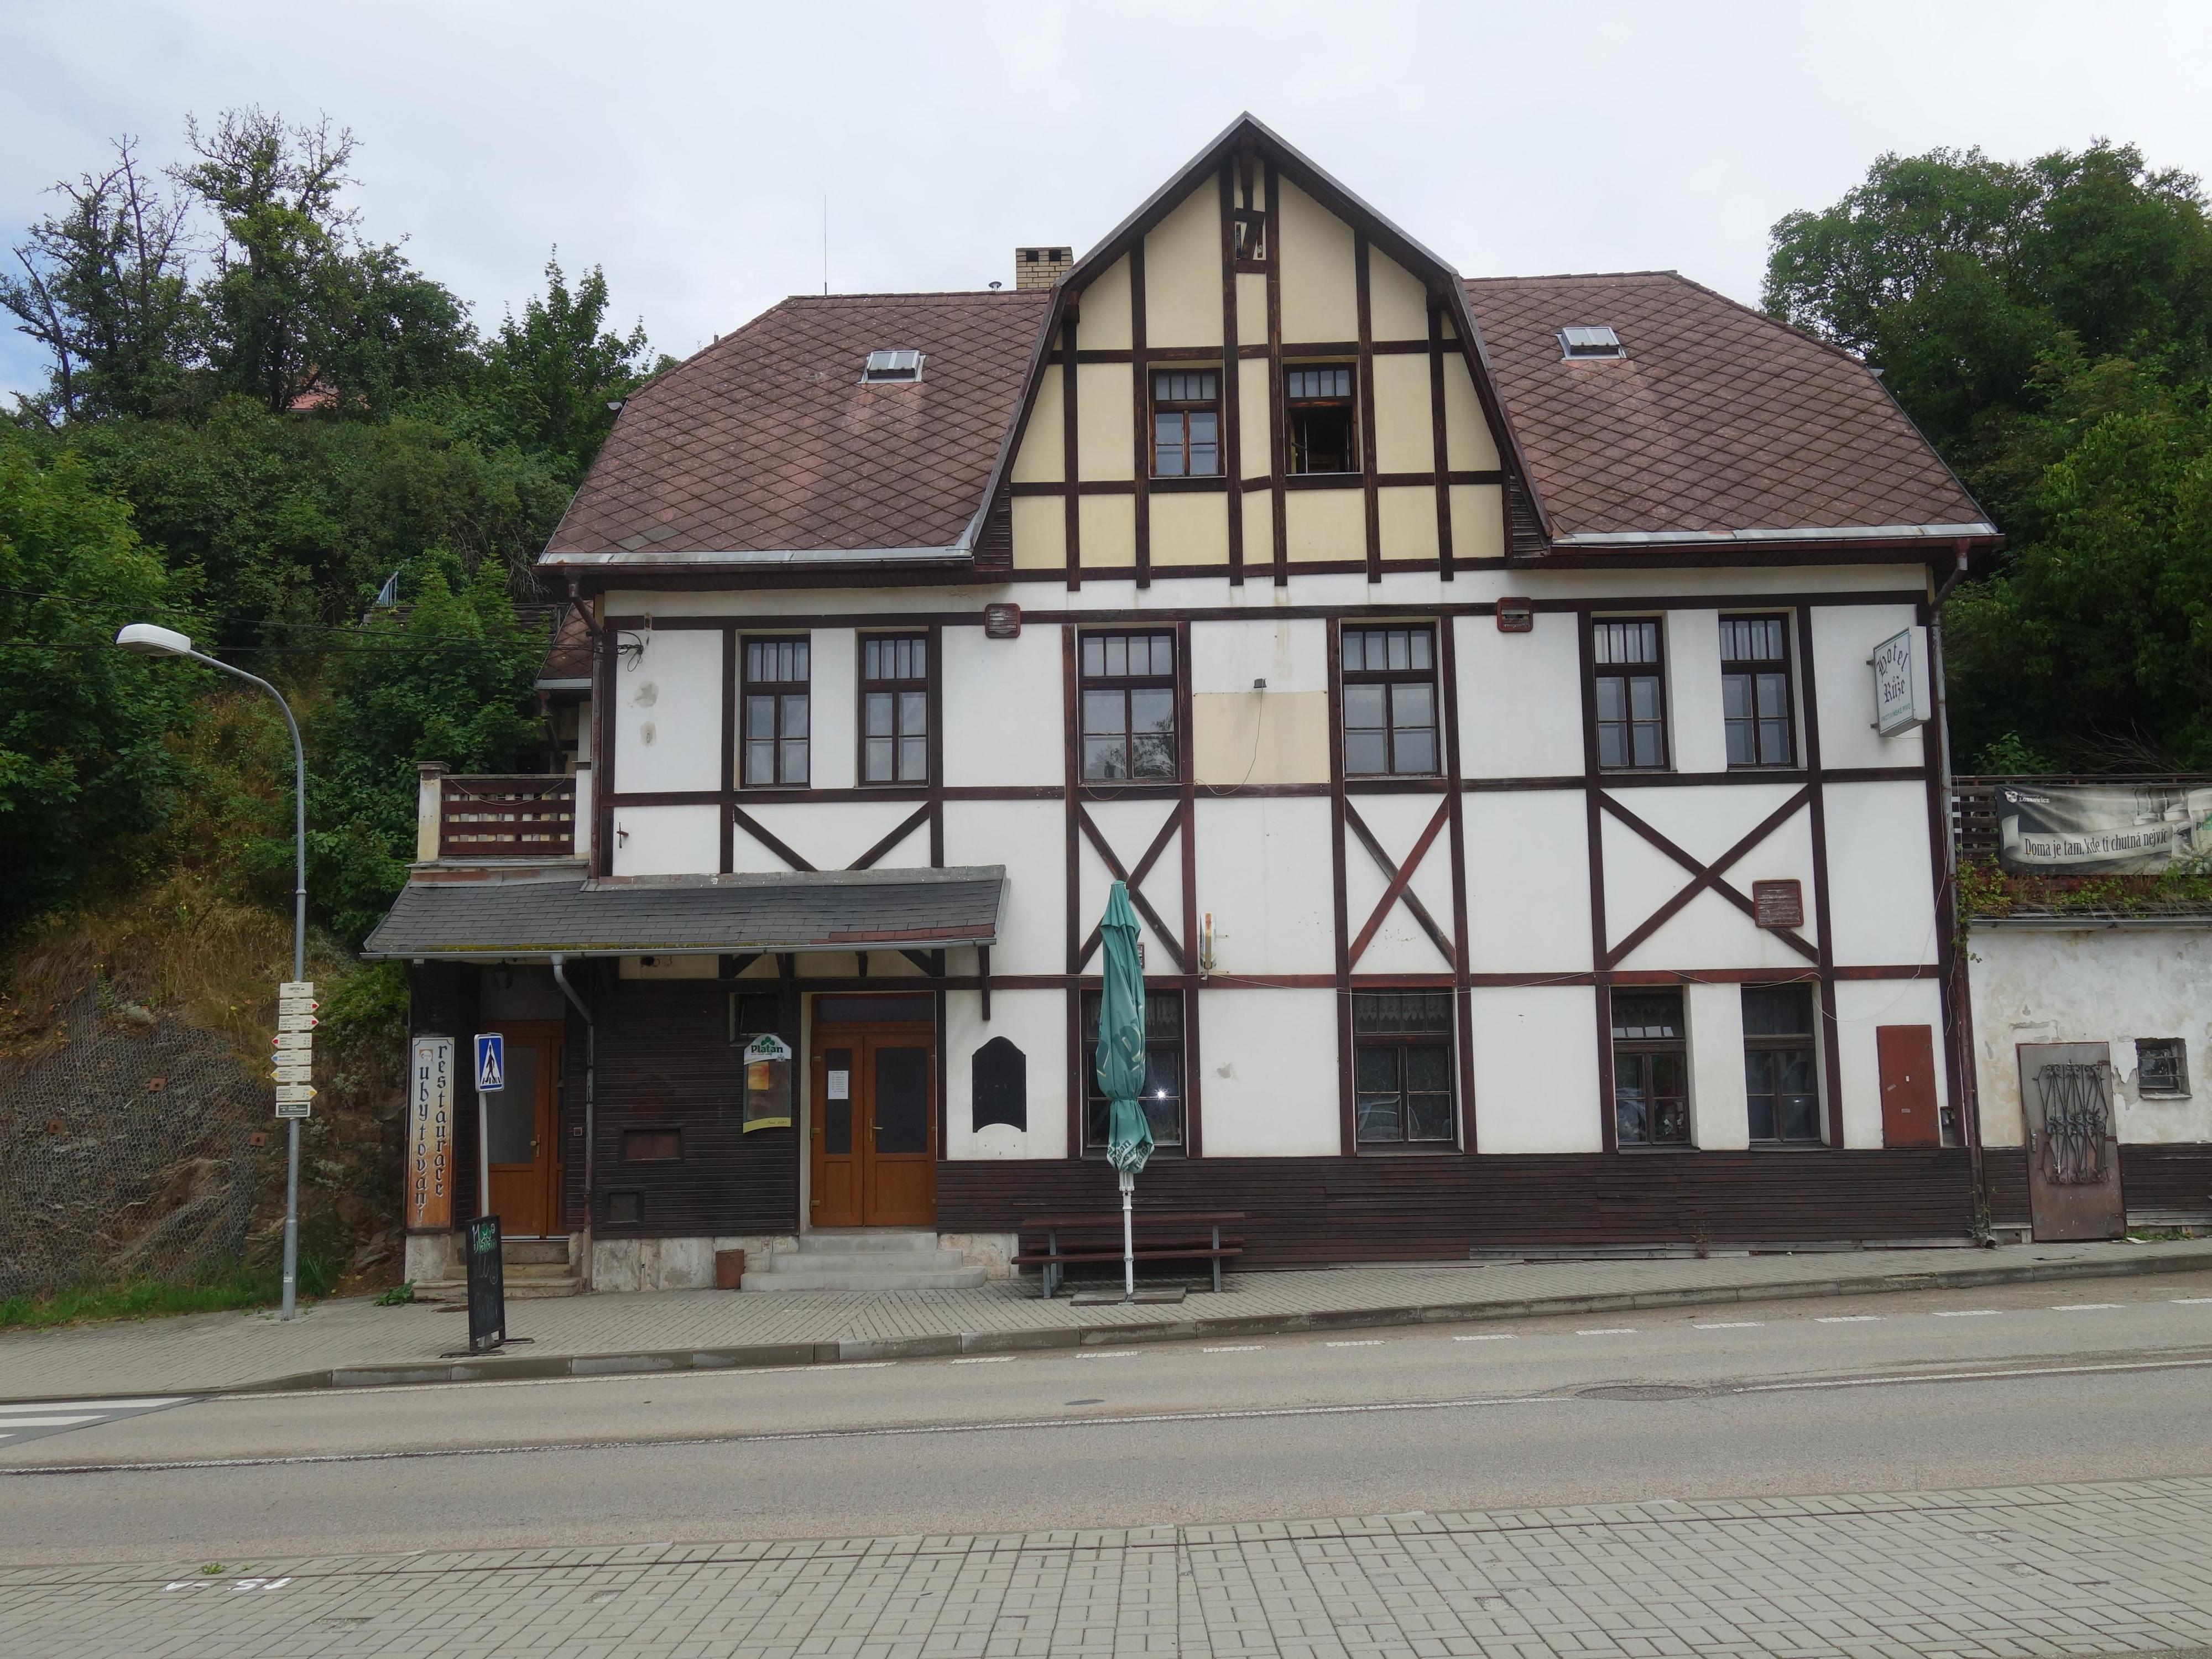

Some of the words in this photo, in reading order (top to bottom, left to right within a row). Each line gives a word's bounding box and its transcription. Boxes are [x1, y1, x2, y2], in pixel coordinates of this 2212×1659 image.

[1876, 641, 1908, 682] Hotel
[2025, 838, 2051, 857] Doma
[2052, 840, 2062, 859] je
[2064, 842, 2084, 857] tam,
[2085, 837, 2100, 854] kde
[2111, 832, 2142, 852] chutná
[2143, 828, 2168, 848] nejvíc
[751, 1044, 784, 1053] Platan
[434, 1045, 447, 1197] restaurace
[415, 1066, 430, 1222] ubytování
